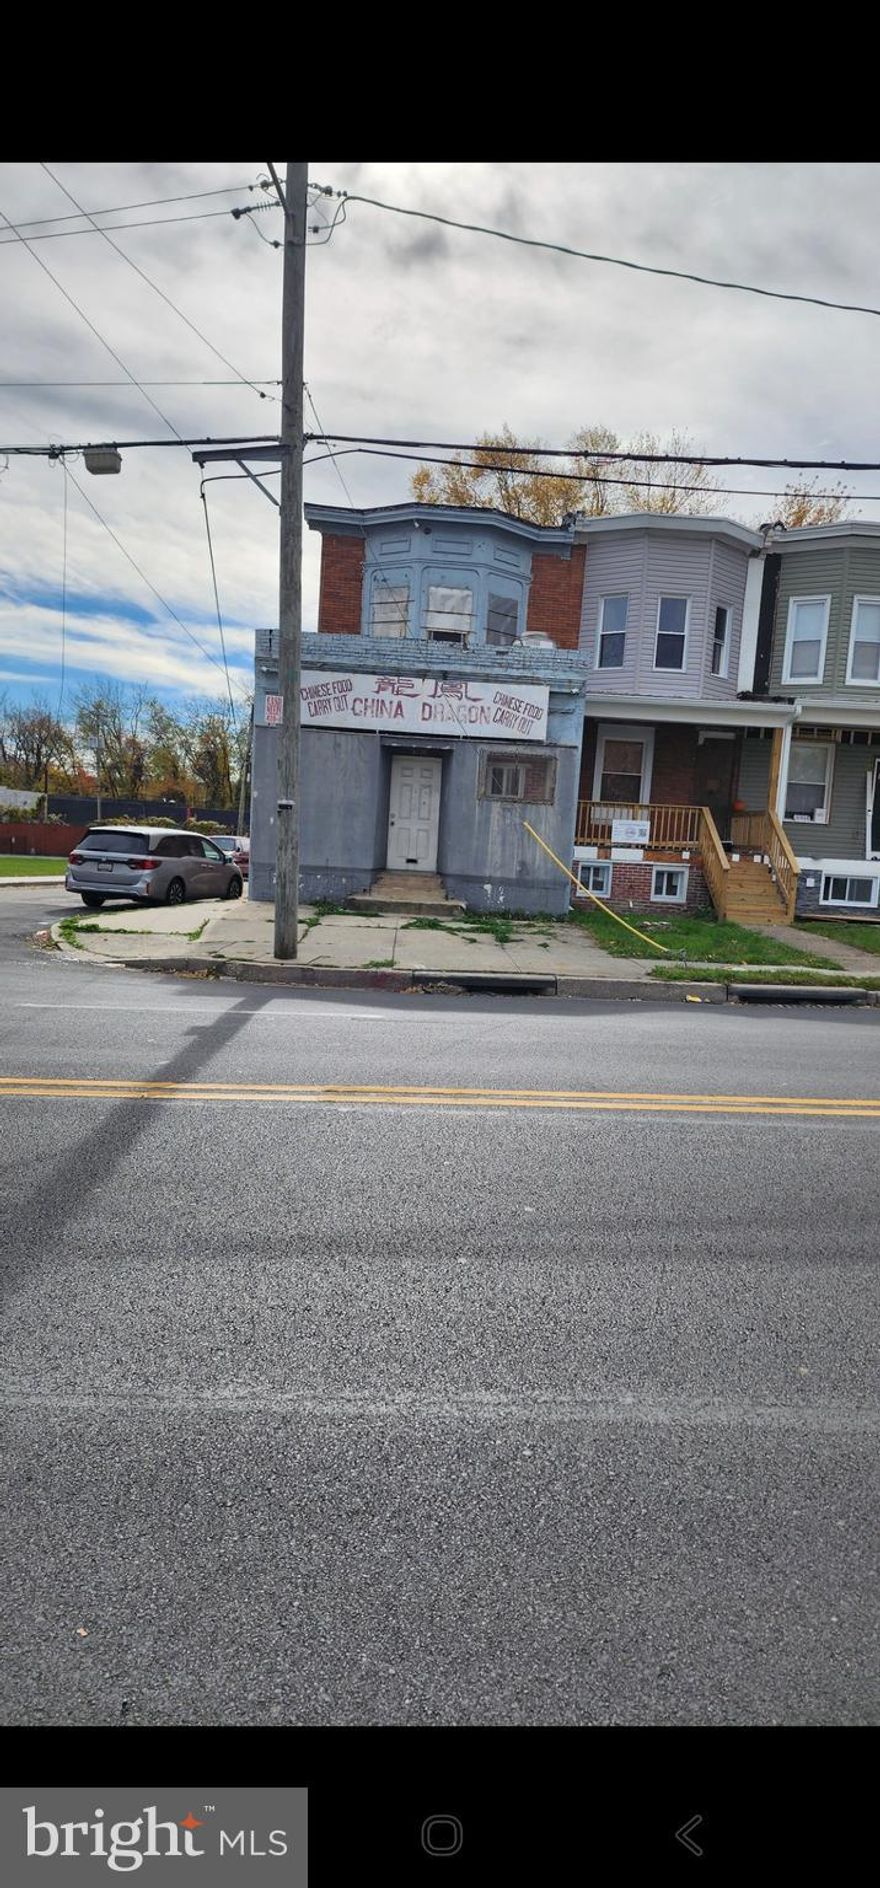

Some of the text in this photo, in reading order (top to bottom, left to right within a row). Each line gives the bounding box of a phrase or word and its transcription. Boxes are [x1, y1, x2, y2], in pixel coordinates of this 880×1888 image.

[301, 678, 353, 701] CHINESE FOOD
[308, 695, 349, 717] CARRY OUT
[352, 697, 404, 719] CHINA
[493, 691, 544, 721] CHINESE FOOD
[493, 706, 536, 736] CARRY OUT
